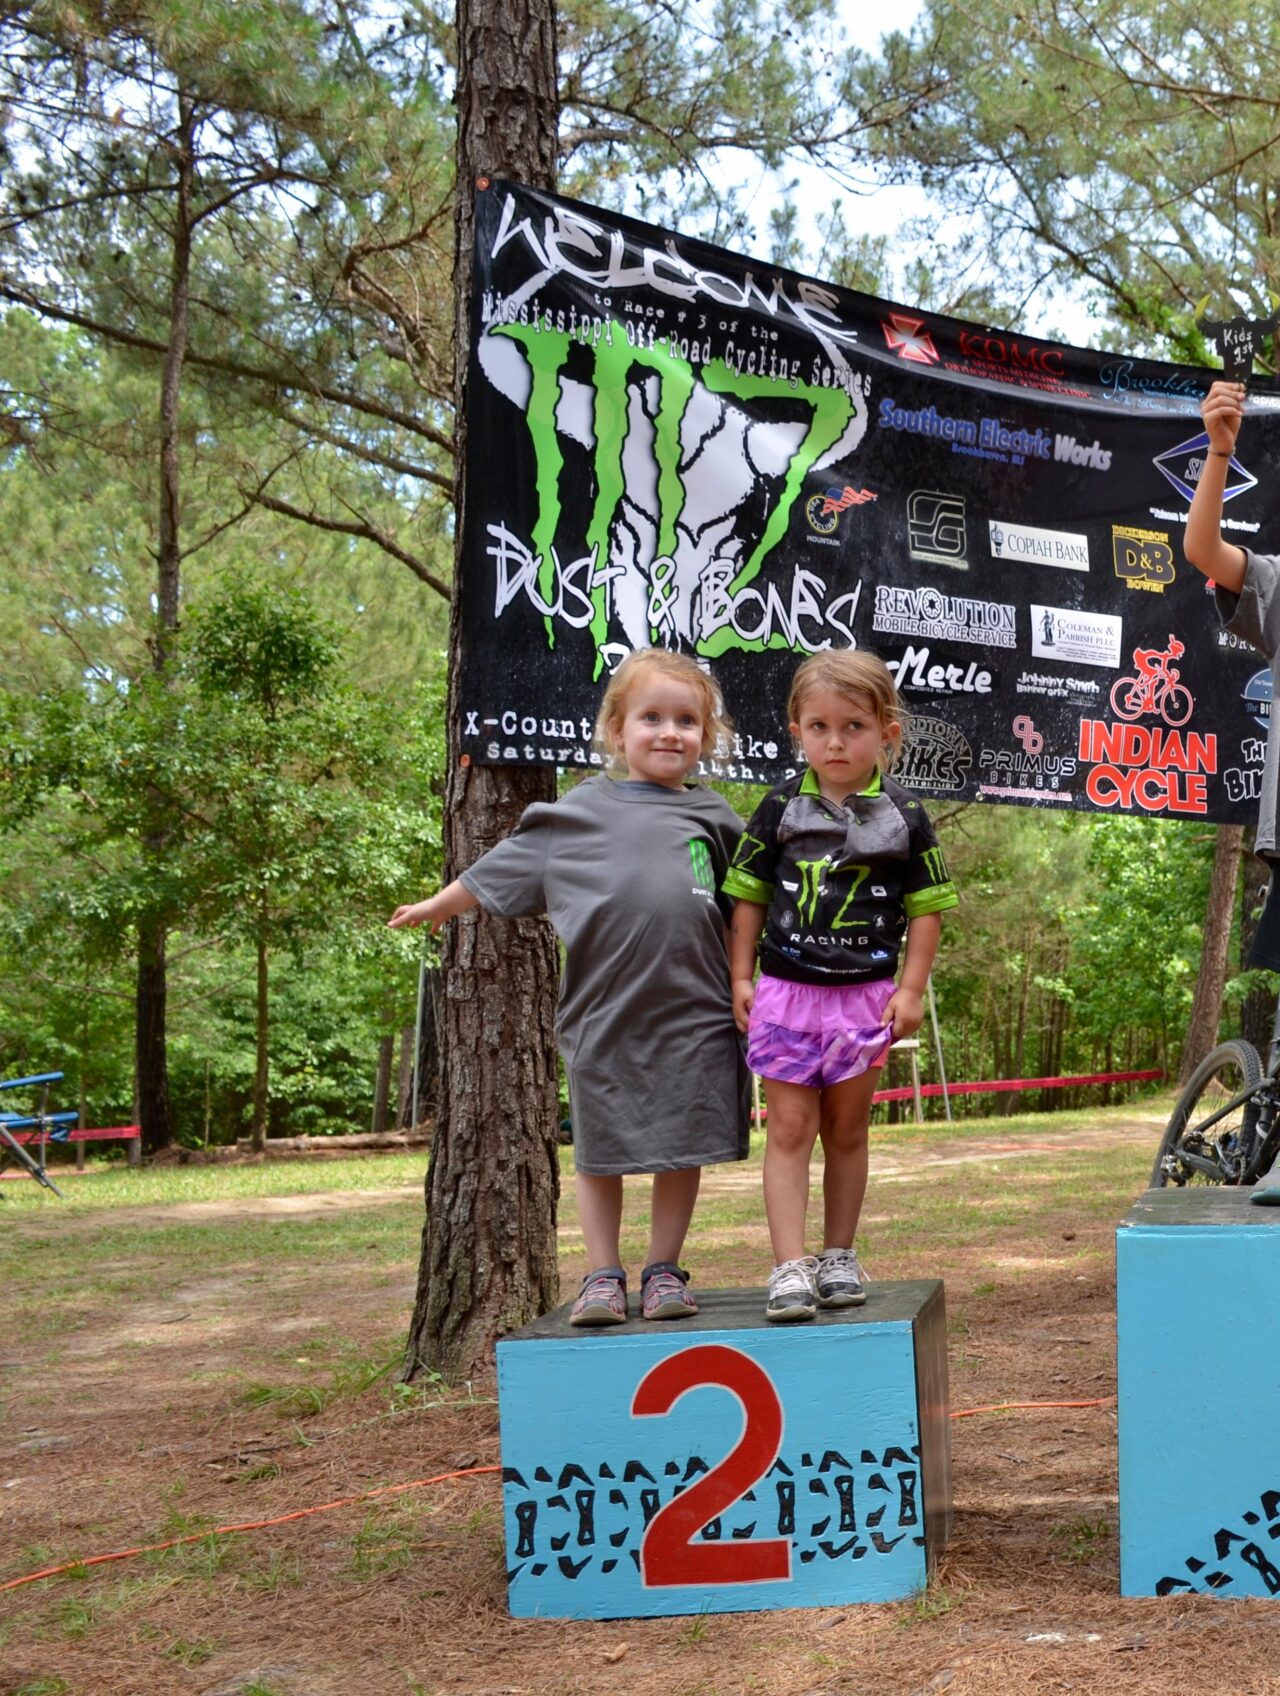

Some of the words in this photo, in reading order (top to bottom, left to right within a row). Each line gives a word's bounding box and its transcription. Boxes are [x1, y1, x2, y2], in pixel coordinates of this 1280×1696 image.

[594, 293, 612, 307] to
[624, 300, 665, 318] Race
[698, 314, 707, 329] 3
[719, 319, 739, 333] of
[751, 325, 779, 341] the
[481, 290, 613, 348] Mississippi
[625, 318, 712, 366] Off-Road
[725, 339, 801, 390] Cycling
[811, 354, 872, 398] Series
[959, 331, 1064, 376] KDMC
[1223, 327, 1253, 347] Kids
[1233, 343, 1253, 365] 1st
[878, 397, 977, 444] Southern
[978, 417, 1051, 460] Electric
[1054, 433, 1113, 471] Works
[806, 535, 840, 547] MOUNTAIN
[1007, 533, 1053, 558] COPIAH
[1055, 540, 1088, 564] BANK
[1111, 524, 1169, 544] DICKERSON
[1112, 534, 1176, 584] D&B
[647, 554, 679, 631] &
[1126, 577, 1165, 593] BOWEN
[874, 585, 1017, 634] REVOLUTION
[872, 614, 919, 633] MOBILE
[919, 619, 968, 642] BICYCLE
[969, 627, 1018, 649] SERVICE
[1057, 618, 1103, 634] COLEMAN
[1105, 626, 1114, 637] &
[1057, 628, 1094, 644] PARRISH
[885, 645, 992, 694] Merle
[979, 749, 1077, 776] PRIMUS
[1078, 718, 1218, 775] INDIAN
[990, 770, 1060, 789] BIKES
[1086, 762, 1208, 814] CYCLE
[790, 933, 869, 946] RACING
[630, 1343, 793, 1589] 2
